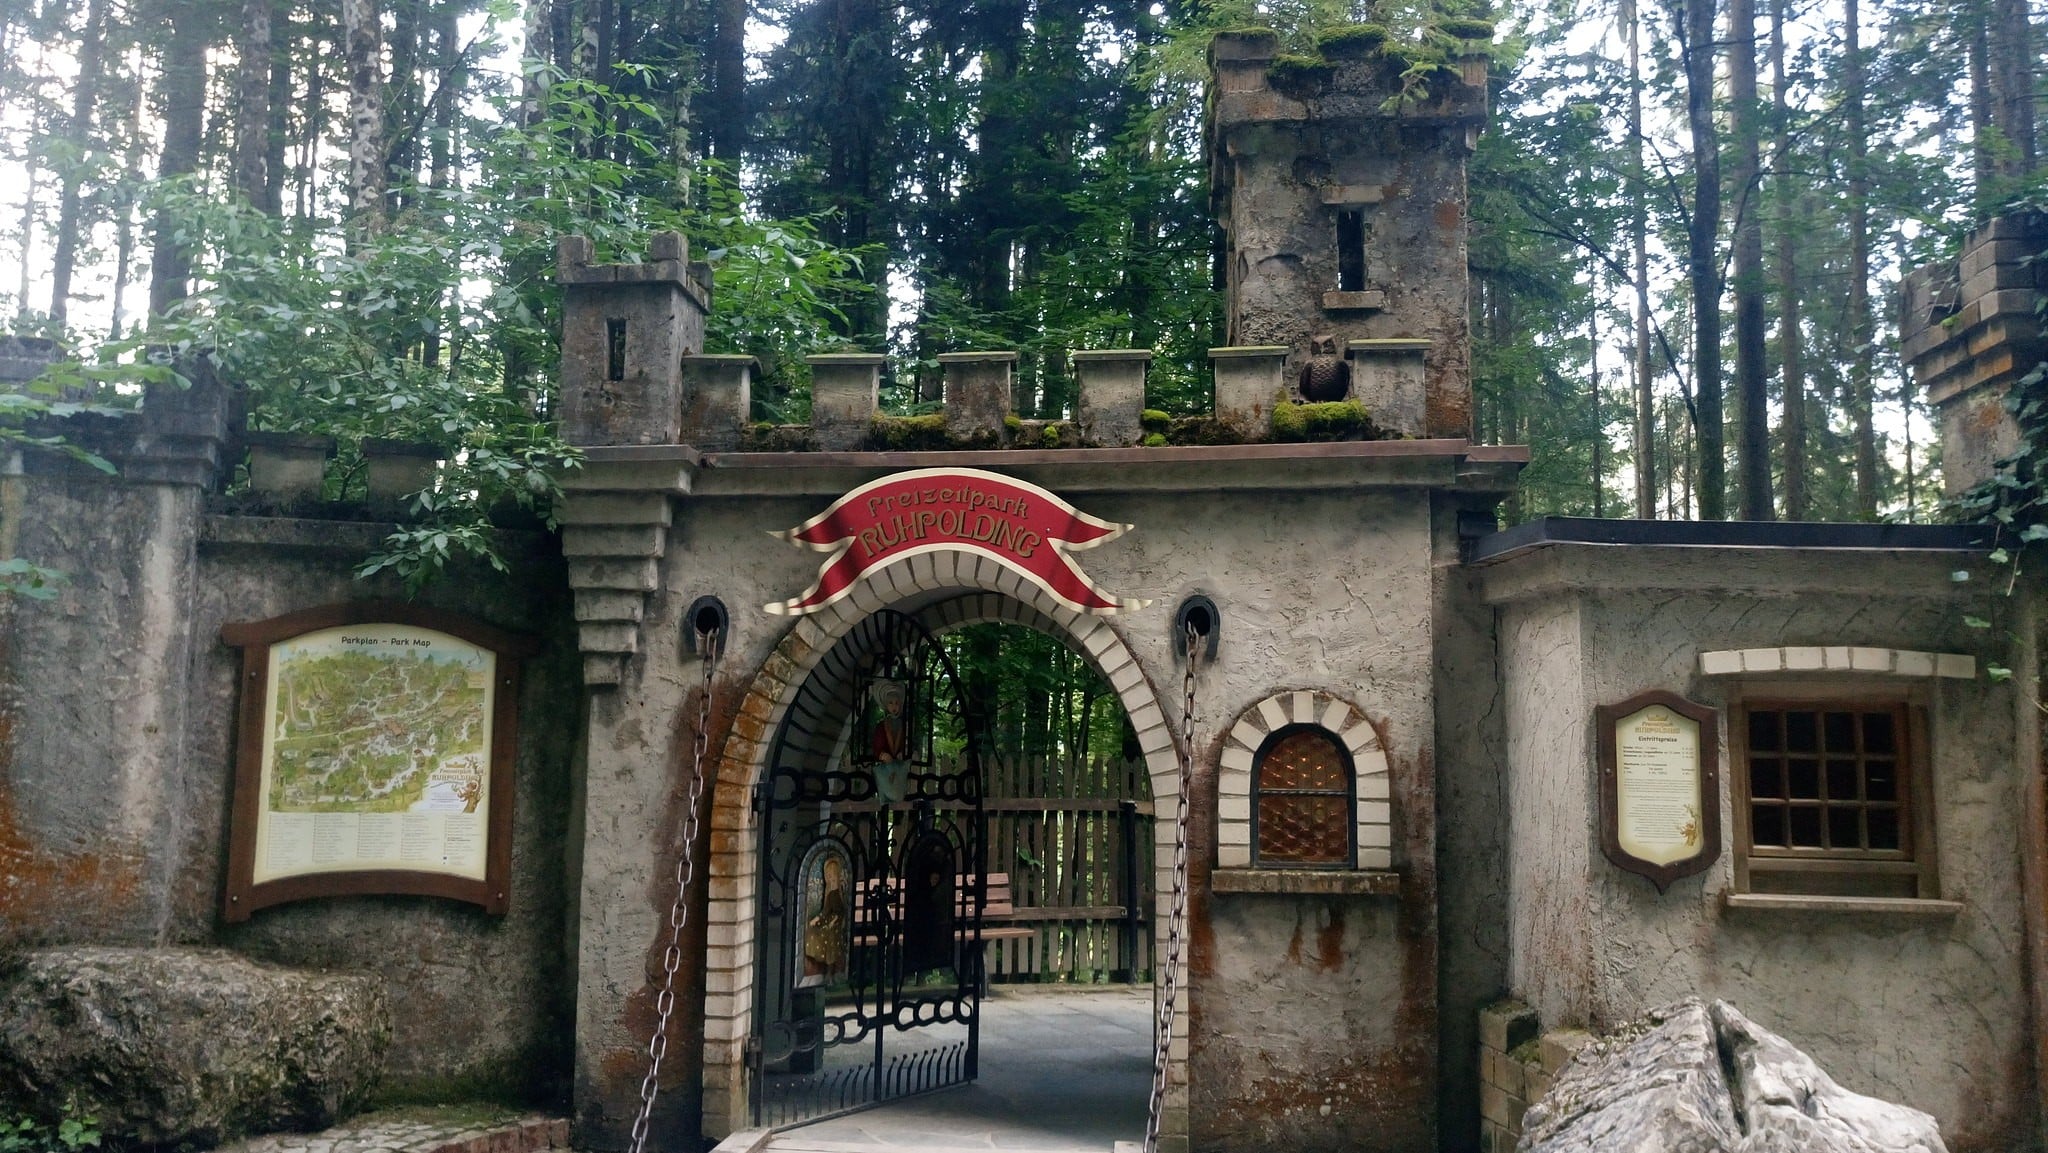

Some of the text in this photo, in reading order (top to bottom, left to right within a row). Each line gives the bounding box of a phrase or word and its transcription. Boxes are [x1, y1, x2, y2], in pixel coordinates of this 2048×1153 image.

[867, 486, 1028, 518] Freizeitpark
[857, 509, 1041, 558] RUHPOLDING
[341, 636, 378, 646] Parkplan
[391, 637, 409, 646] Park
[413, 639, 431, 648] Map
